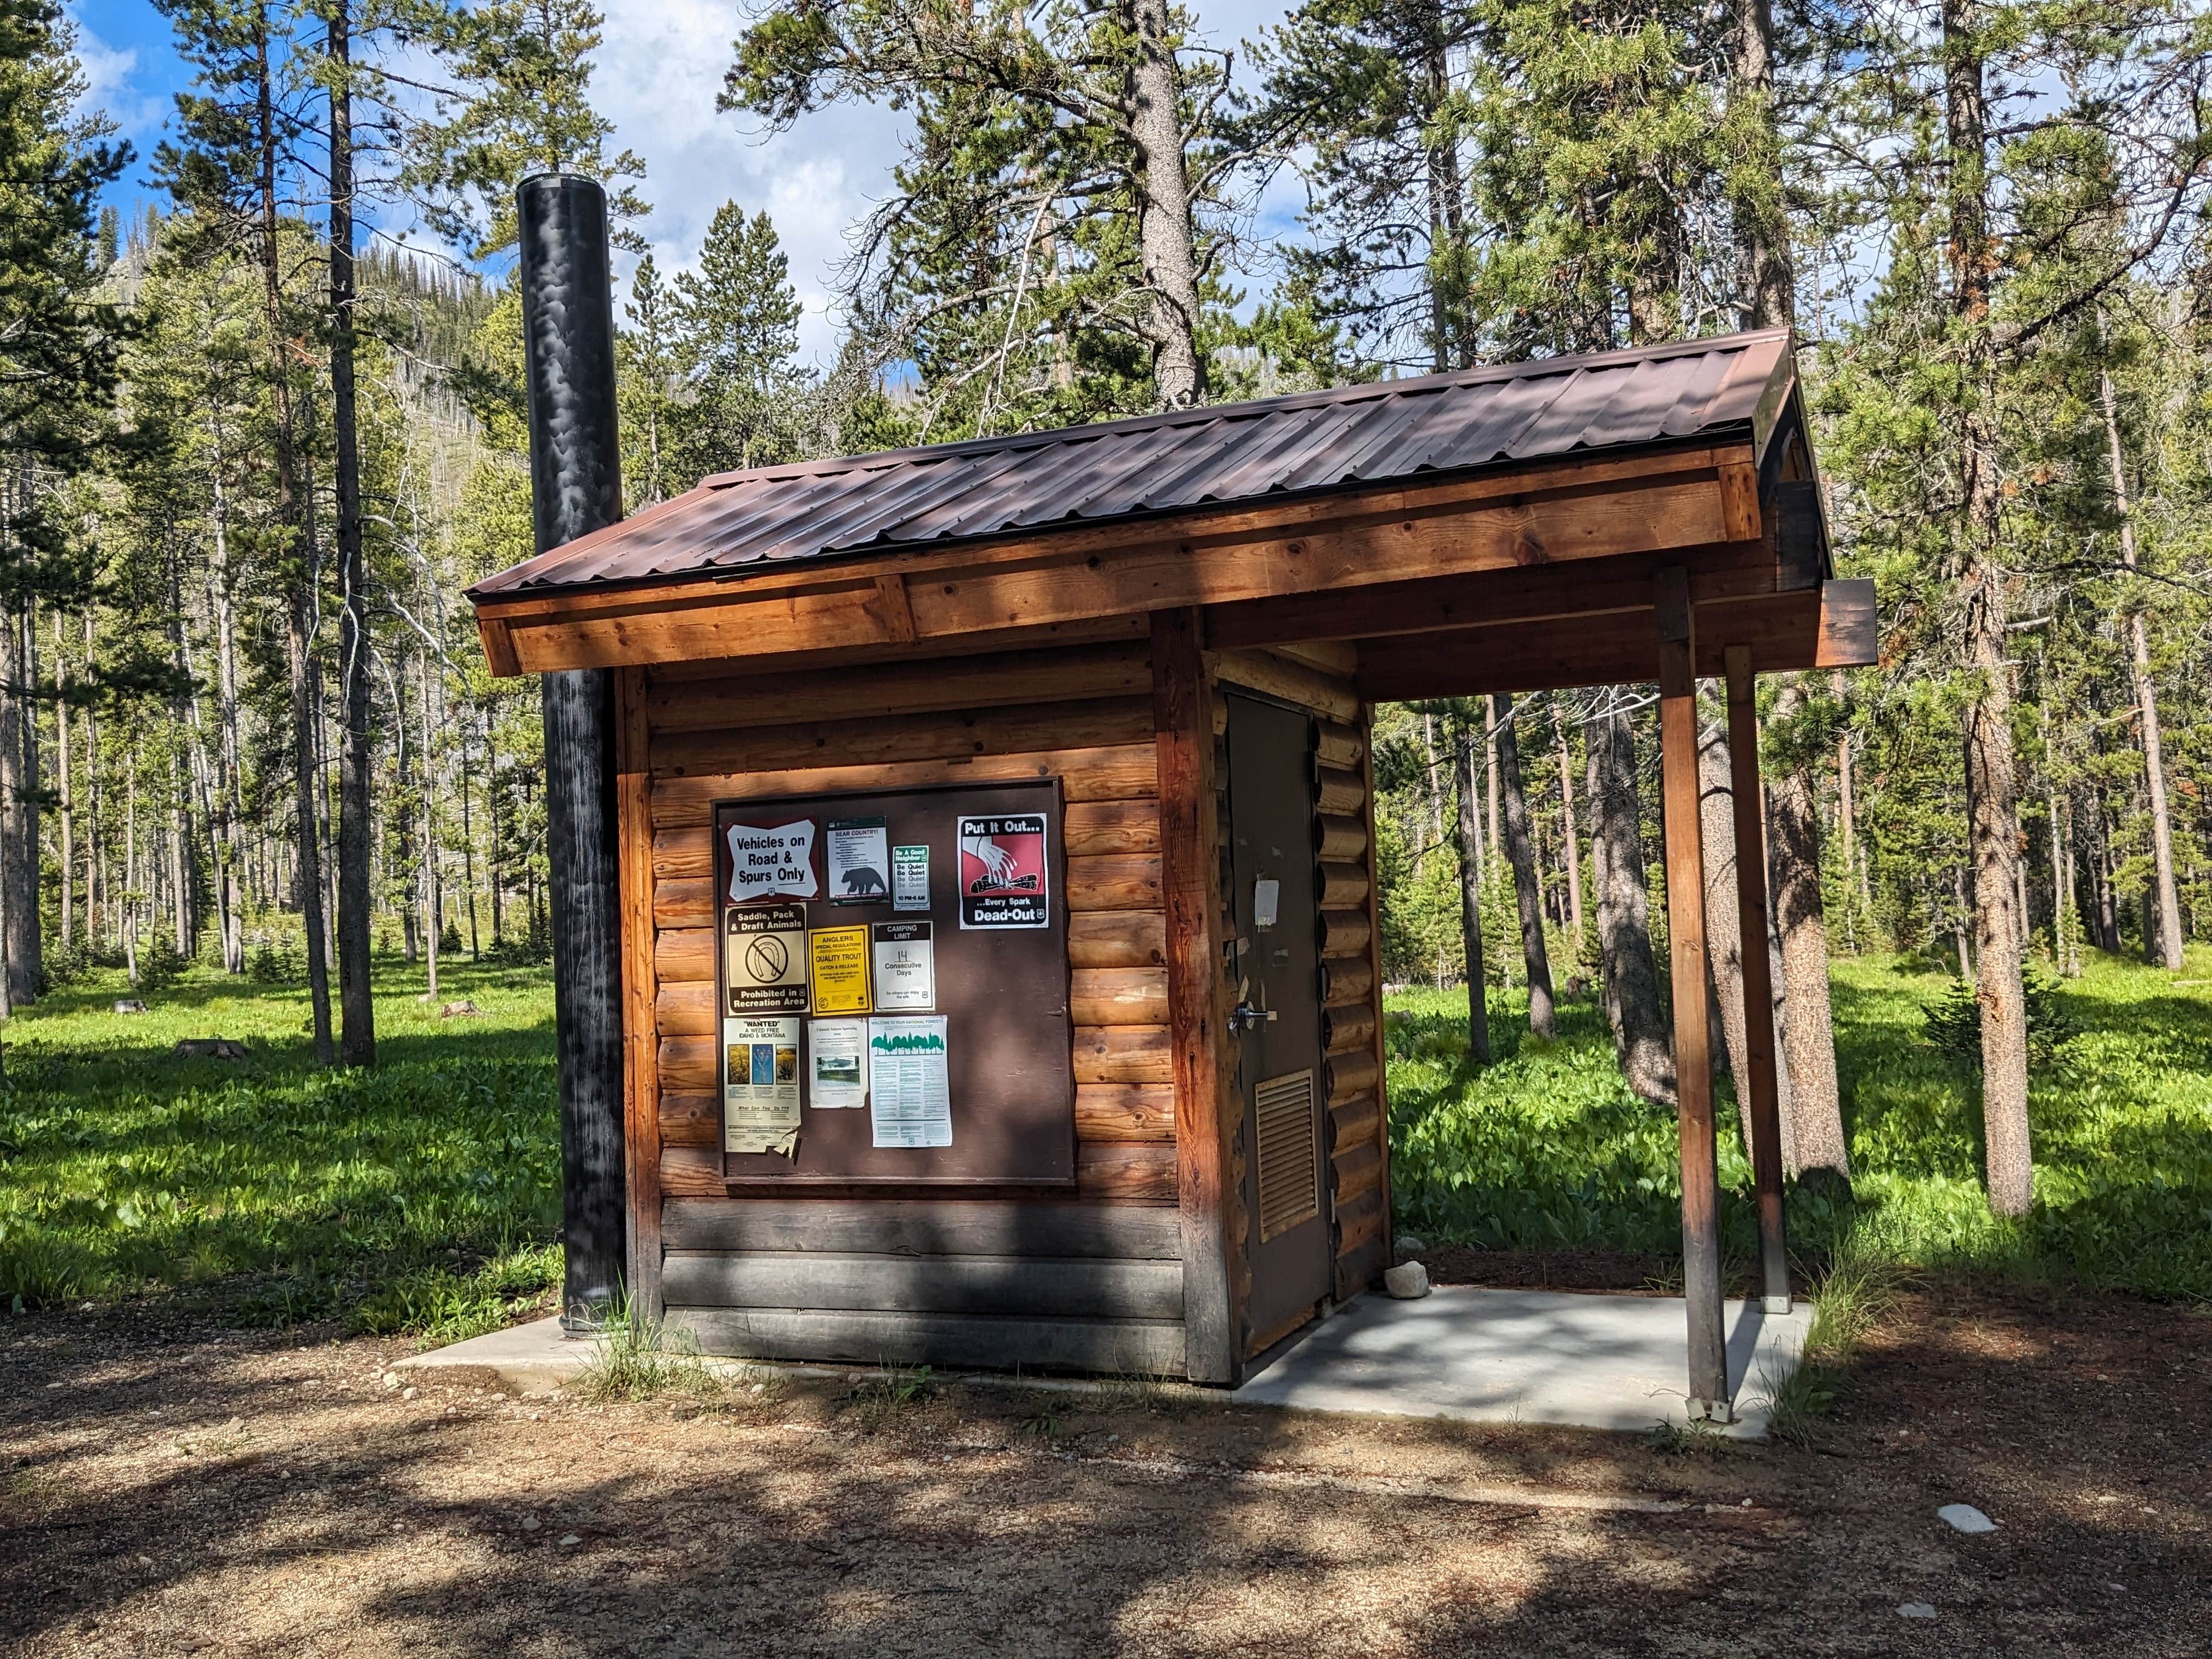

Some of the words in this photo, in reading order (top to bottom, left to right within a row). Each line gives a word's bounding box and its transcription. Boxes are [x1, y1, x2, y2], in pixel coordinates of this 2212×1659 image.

[965, 822, 985, 834] Put
[990, 821, 999, 833] It
[1005, 820, 1040, 833] Out...
[737, 836, 784, 850] Vehicles
[790, 837, 805, 846] on
[748, 851, 778, 866] Road
[784, 850, 792, 864] &
[739, 870, 772, 885] Spurs
[777, 867, 805, 882] Only
[977, 898, 1006, 907] ...Every
[1009, 897, 1031, 906] Spark
[737, 912, 770, 921] Saddle,
[773, 911, 794, 919] Pack
[974, 908, 1035, 922] Dead-Out
[731, 923, 737, 931] &
[741, 922, 764, 930] Draft
[767, 920, 802, 929] Animals
[887, 924, 917, 933] CAMPING
[816, 954, 840, 963] QUALITY
[897, 950, 907, 962] 14
[896, 969, 912, 977] Days
[741, 989, 786, 998] Prohibited
[733, 998, 781, 1008] Recreation
[783, 997, 805, 1006] Area
